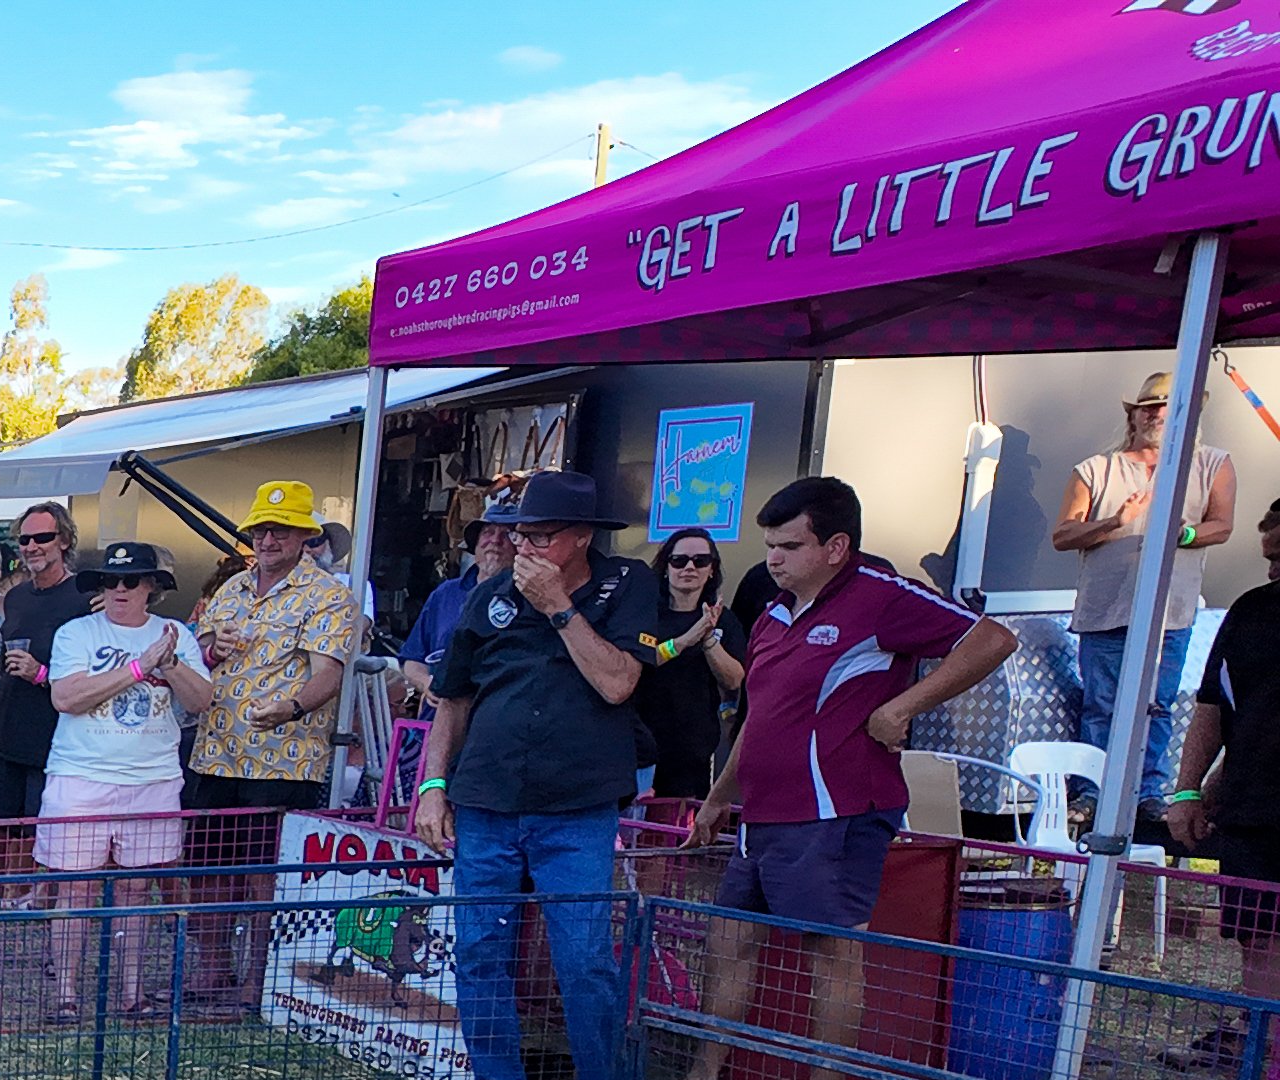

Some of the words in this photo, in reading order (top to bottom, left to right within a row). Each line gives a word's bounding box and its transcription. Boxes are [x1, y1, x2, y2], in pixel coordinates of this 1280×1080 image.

[768, 201, 799, 258] A
[831, 131, 1078, 255] LITTLE
[394, 275, 458, 308] 0427
[466, 261, 519, 293] 660
[529, 246, 589, 280] 034
[274, 991, 368, 1035] THOROUGHBRED
[374, 1025, 431, 1057] RACING
[348, 1040, 392, 1070] 660
